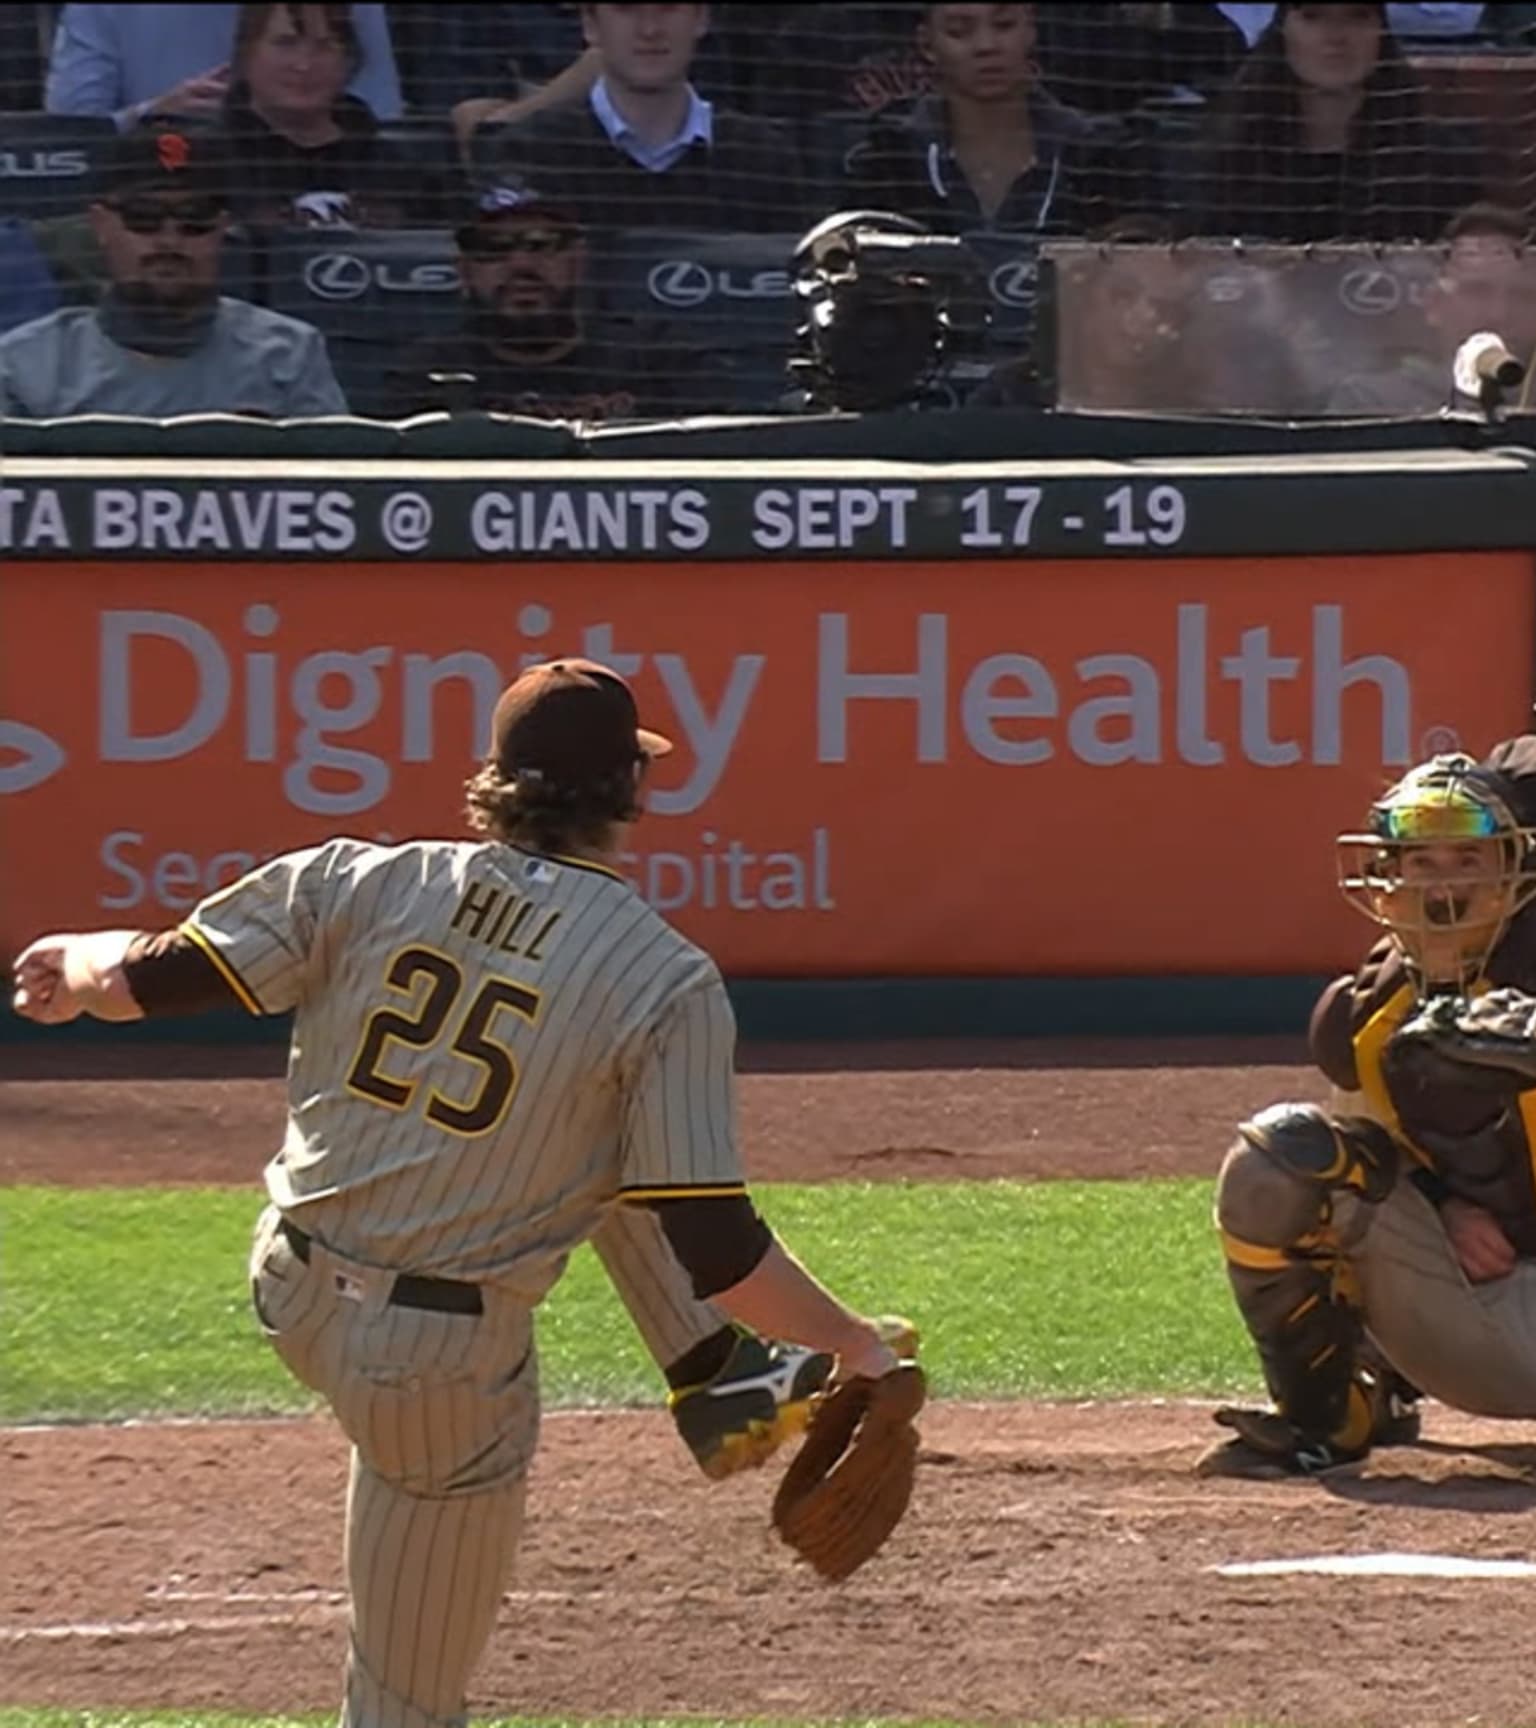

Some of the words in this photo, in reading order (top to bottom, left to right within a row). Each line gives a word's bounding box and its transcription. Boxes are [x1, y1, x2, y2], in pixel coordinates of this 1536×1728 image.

[93, 489, 356, 551] BRAVES
[381, 493, 433, 551] @
[471, 490, 710, 552] GIANTS
[753, 490, 917, 549] SEPT
[960, 487, 1042, 547] 17
[1103, 486, 1186, 546] 19
[817, 604, 1412, 767] Health
[451, 882, 563, 961] HILL
[346, 944, 543, 1138] 25
